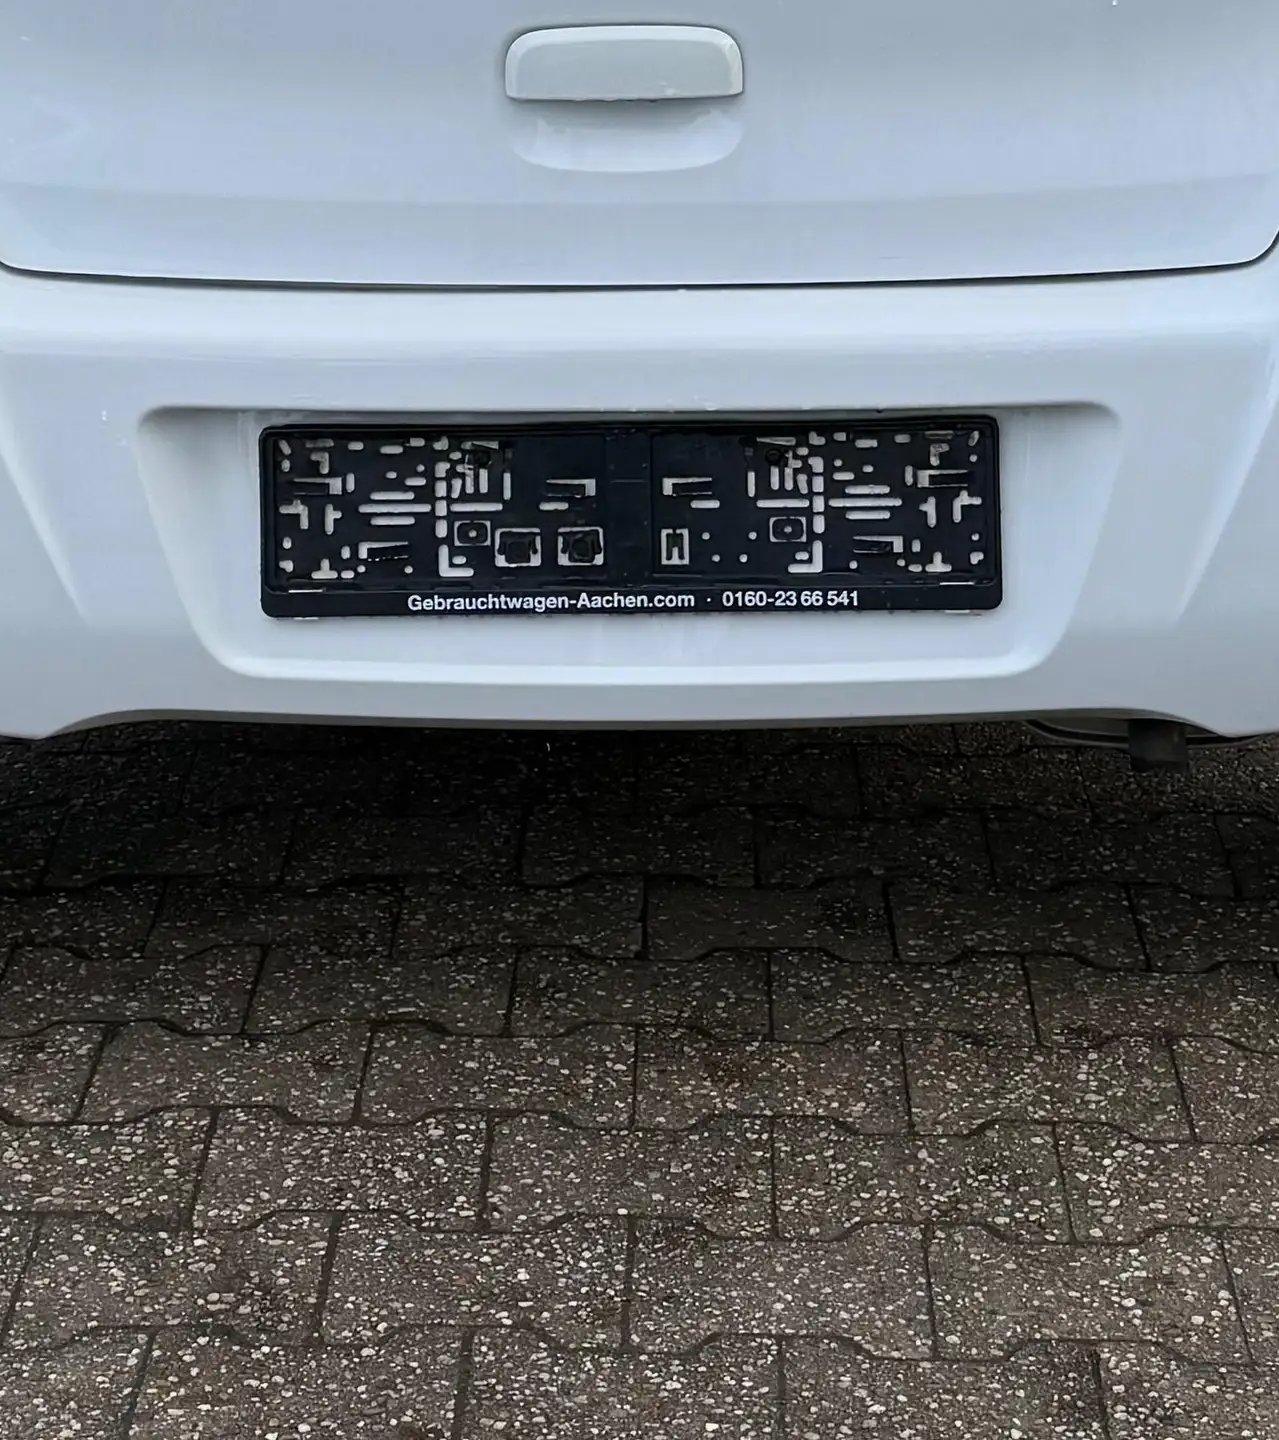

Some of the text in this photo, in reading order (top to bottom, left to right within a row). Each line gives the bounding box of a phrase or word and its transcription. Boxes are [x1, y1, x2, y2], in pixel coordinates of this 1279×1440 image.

[407, 590, 858, 612] Gebrauchtwagen-Aachen.com 0160-23 66 541
